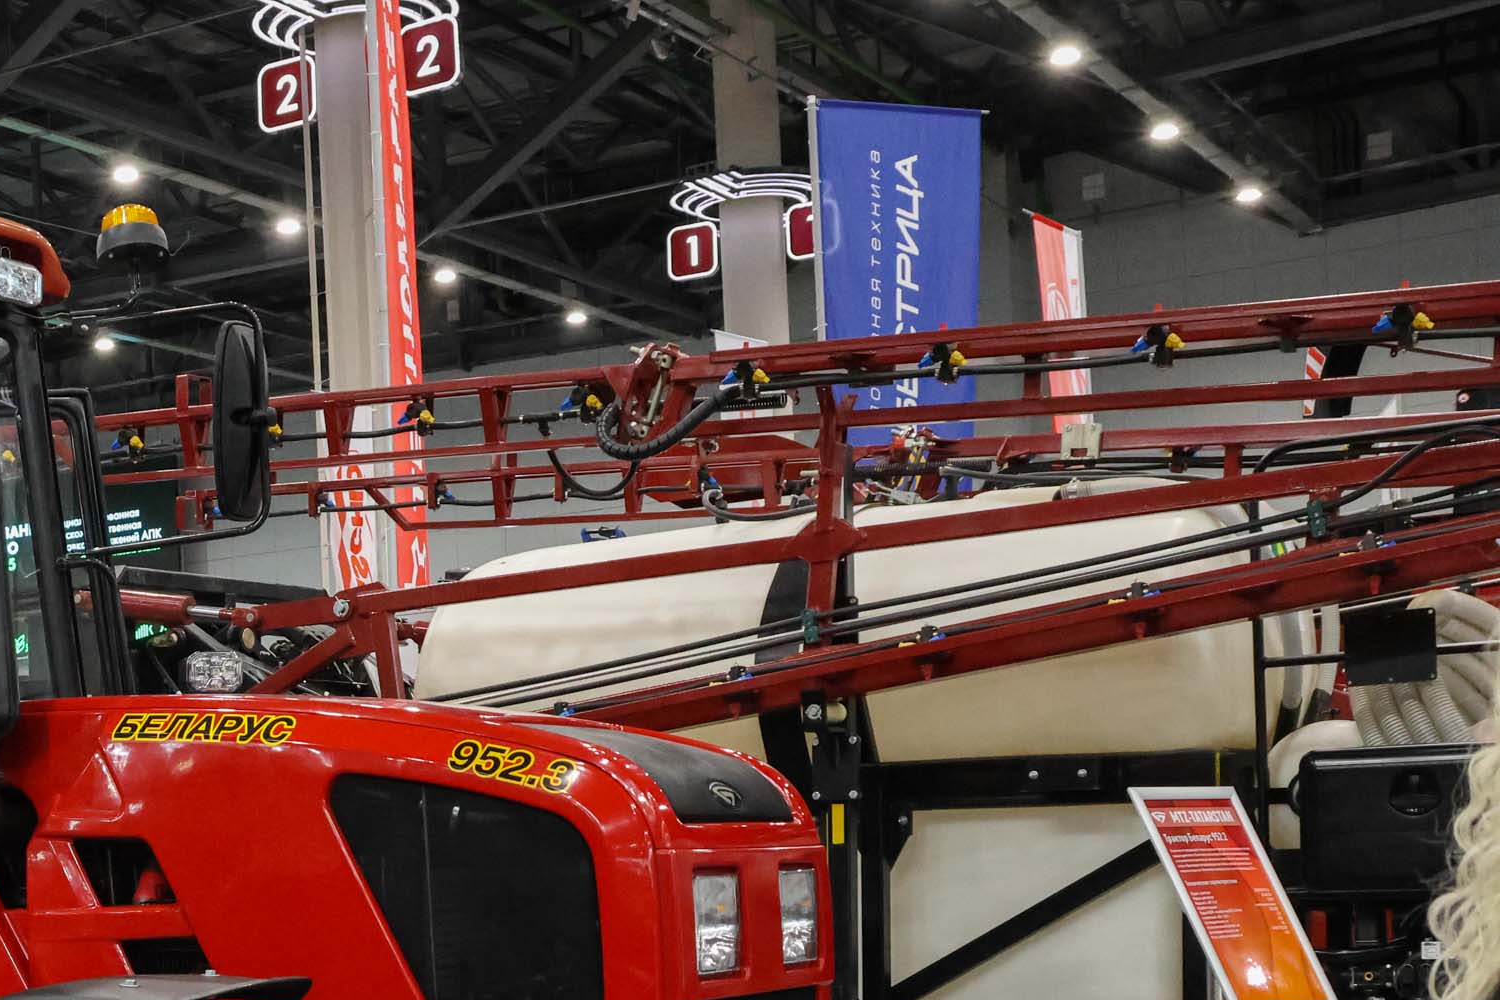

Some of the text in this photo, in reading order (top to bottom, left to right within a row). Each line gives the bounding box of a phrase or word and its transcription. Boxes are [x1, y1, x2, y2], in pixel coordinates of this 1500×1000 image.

[416, 34, 441, 78] 2
[275, 74, 299, 115] 2
[685, 235, 700, 267] 1
[141, 527, 163, 541] АПК
[111, 713, 297, 747] БЕЛАРУС
[447, 739, 576, 794] 952.3
